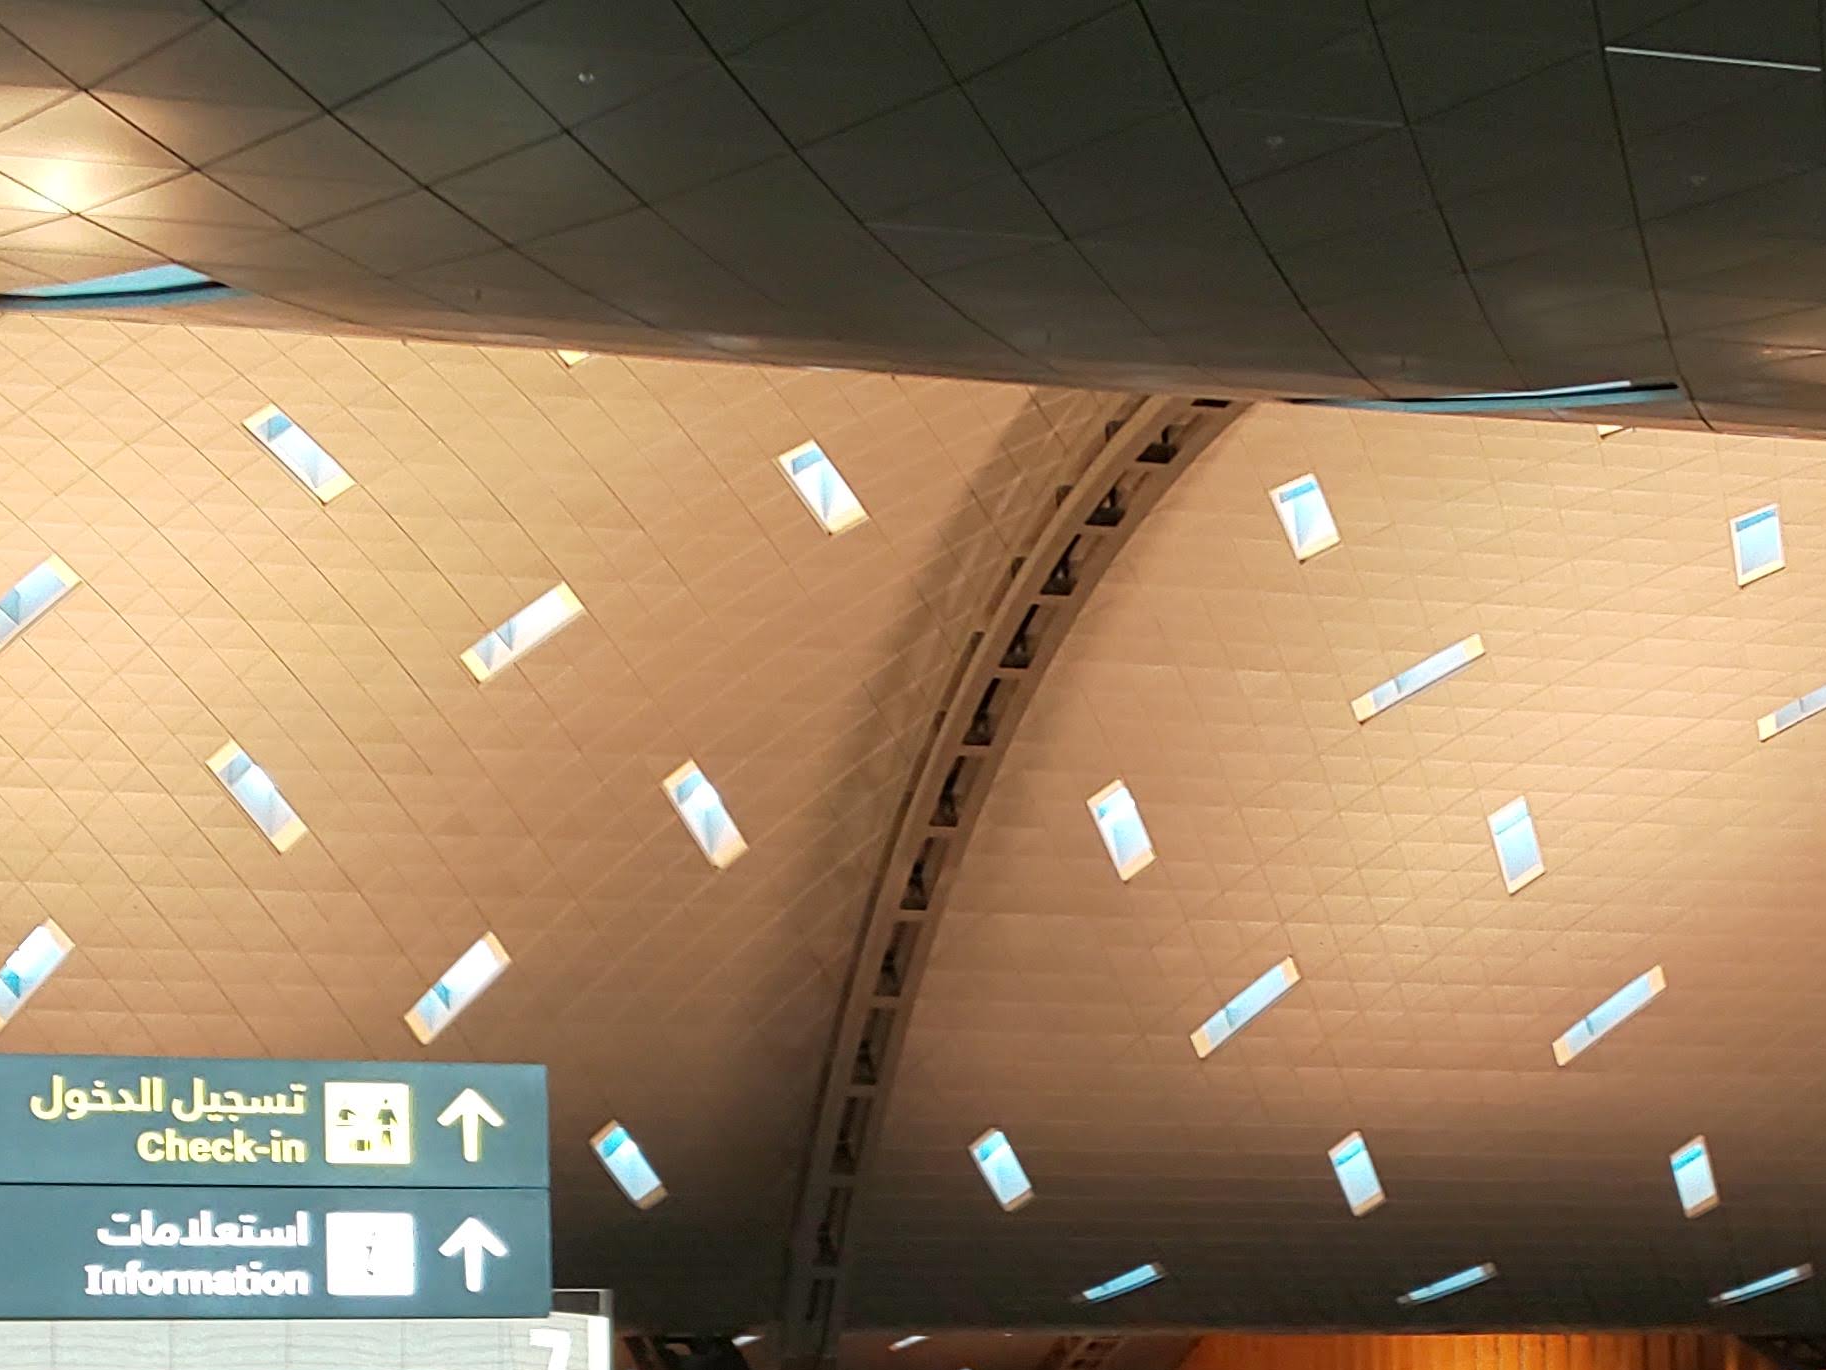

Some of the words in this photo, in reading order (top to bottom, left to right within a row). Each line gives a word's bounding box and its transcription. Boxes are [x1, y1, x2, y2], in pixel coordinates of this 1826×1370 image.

[28, 1074, 167, 1121] الدخول
[171, 1077, 308, 1123] تسجيل
[136, 1127, 307, 1163] Check-in
[96, 1209, 311, 1247] استعلامات
[84, 1260, 311, 1296] Information
